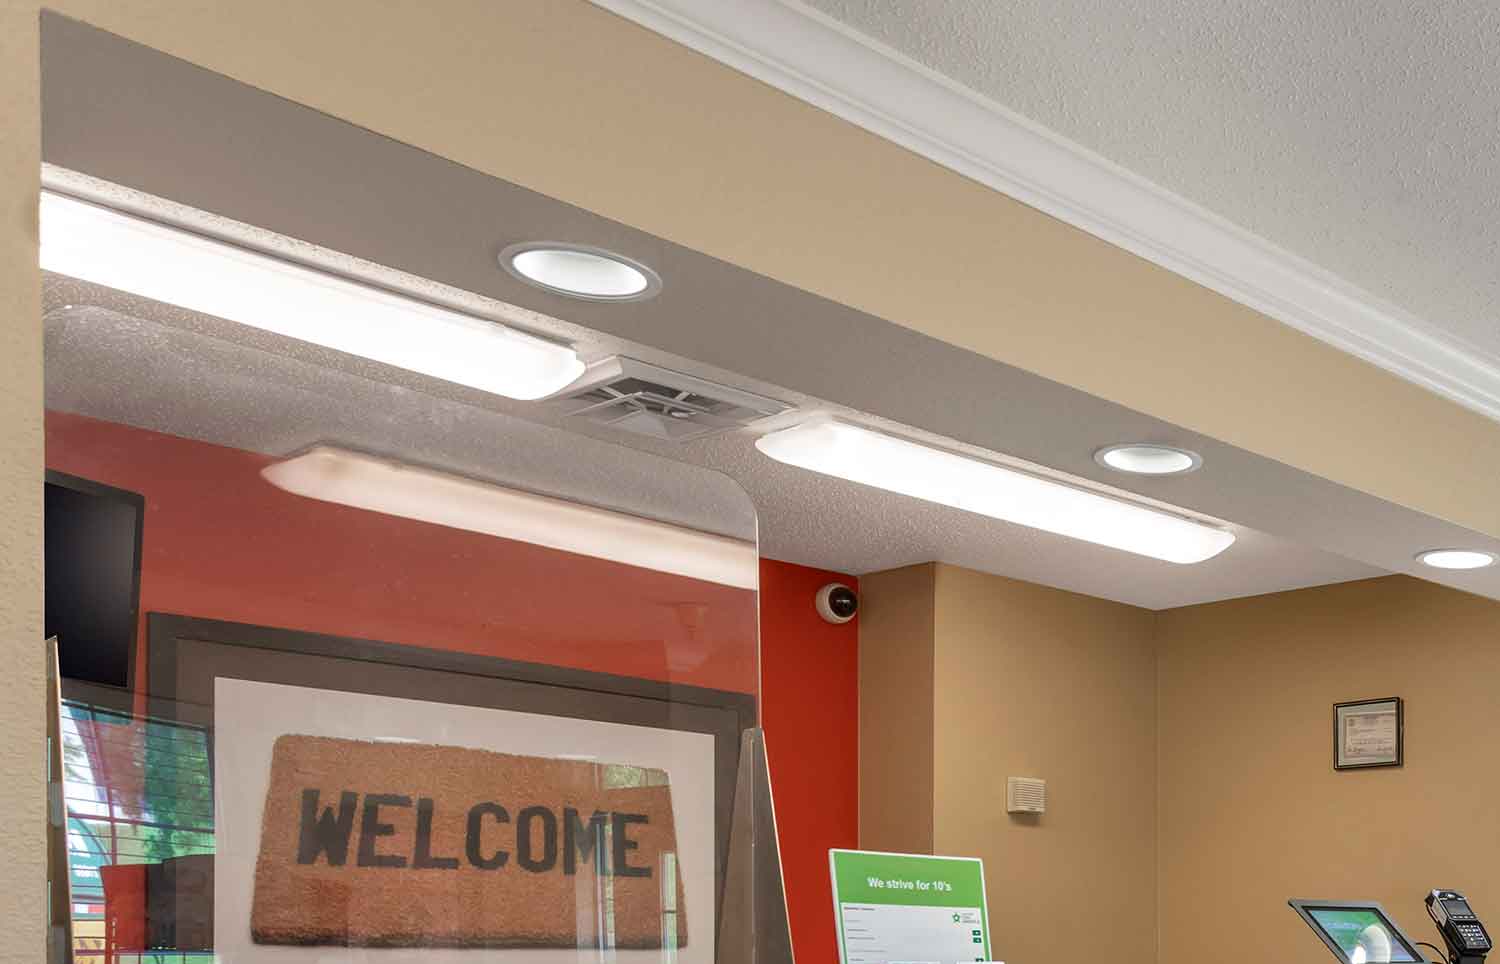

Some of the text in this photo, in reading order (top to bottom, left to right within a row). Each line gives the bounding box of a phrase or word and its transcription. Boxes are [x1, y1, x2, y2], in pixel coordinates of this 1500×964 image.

[296, 786, 654, 879] WELCOME
[867, 876, 952, 892] We strive for 10's
